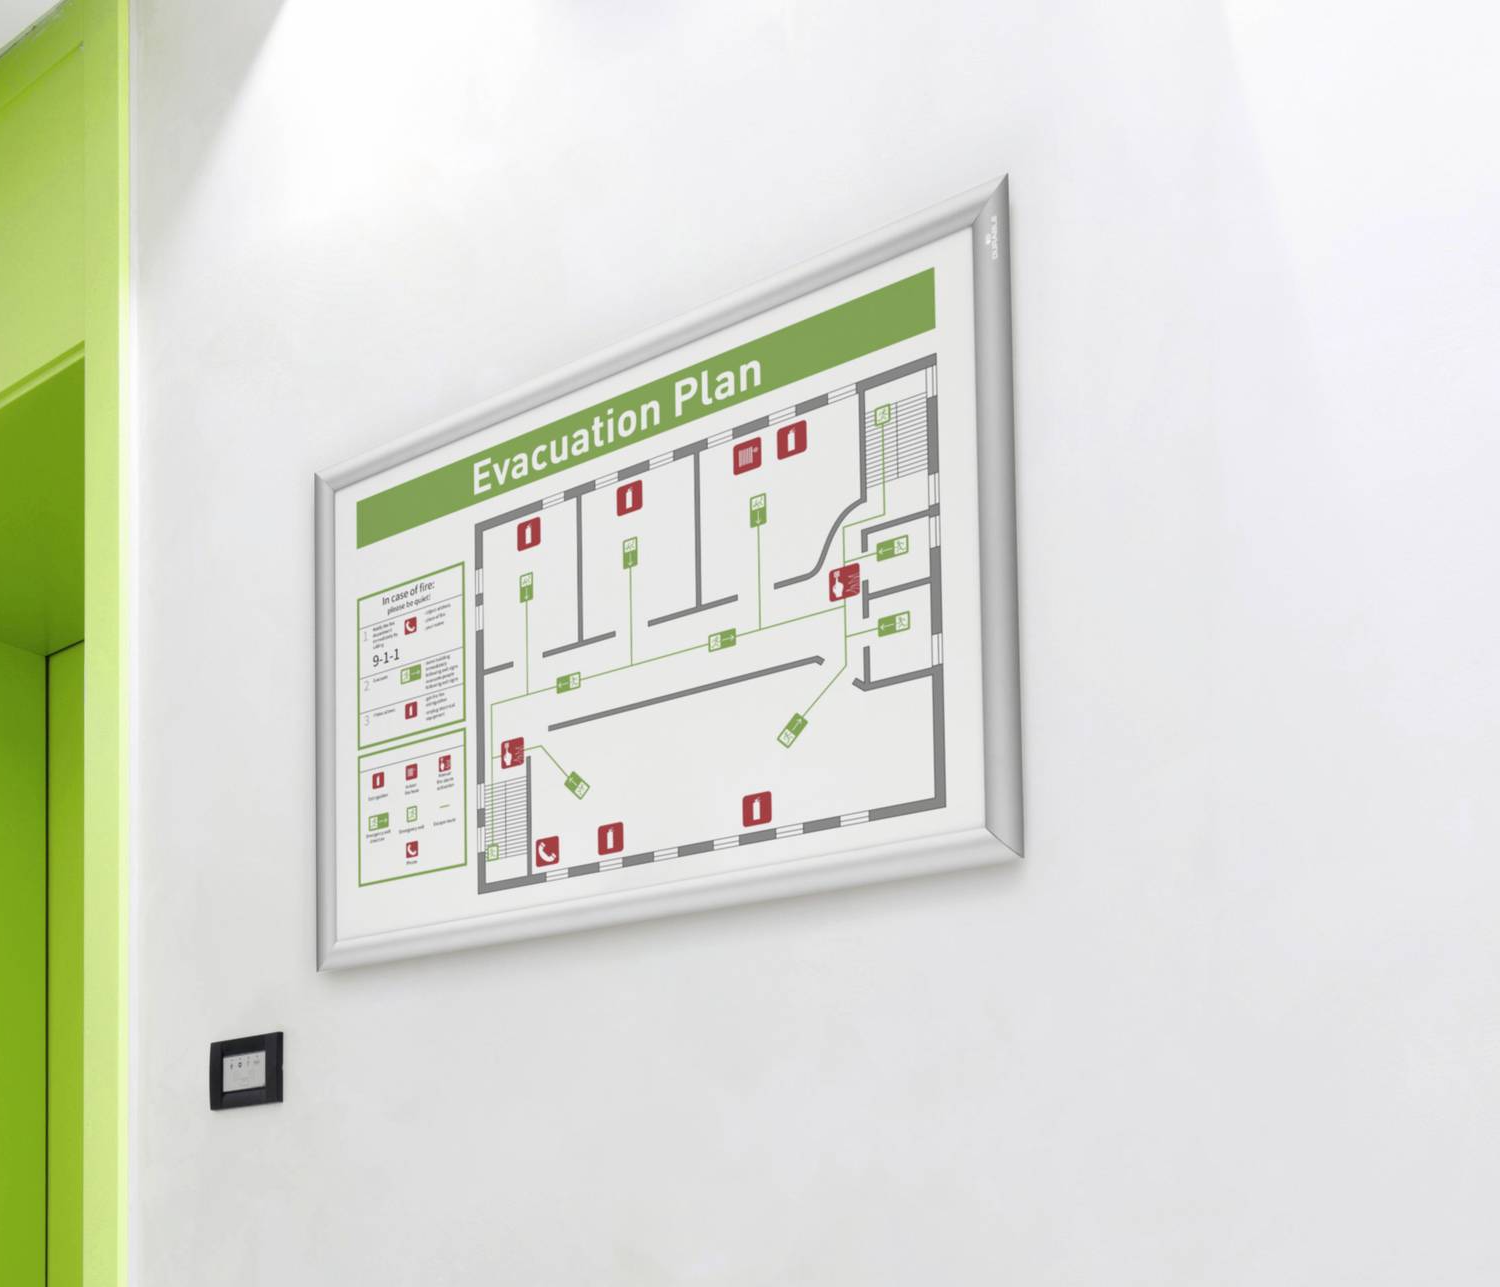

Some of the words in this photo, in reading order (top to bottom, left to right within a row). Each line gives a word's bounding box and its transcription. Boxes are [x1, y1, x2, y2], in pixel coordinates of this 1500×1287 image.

[472, 399, 660, 496] Evacuation
[674, 359, 761, 417] Plan
[382, 596, 390, 606] In
[391, 590, 409, 603] case
[410, 584, 419, 597] of
[419, 581, 435, 593] fire:
[372, 648, 400, 667] 9-1-1
